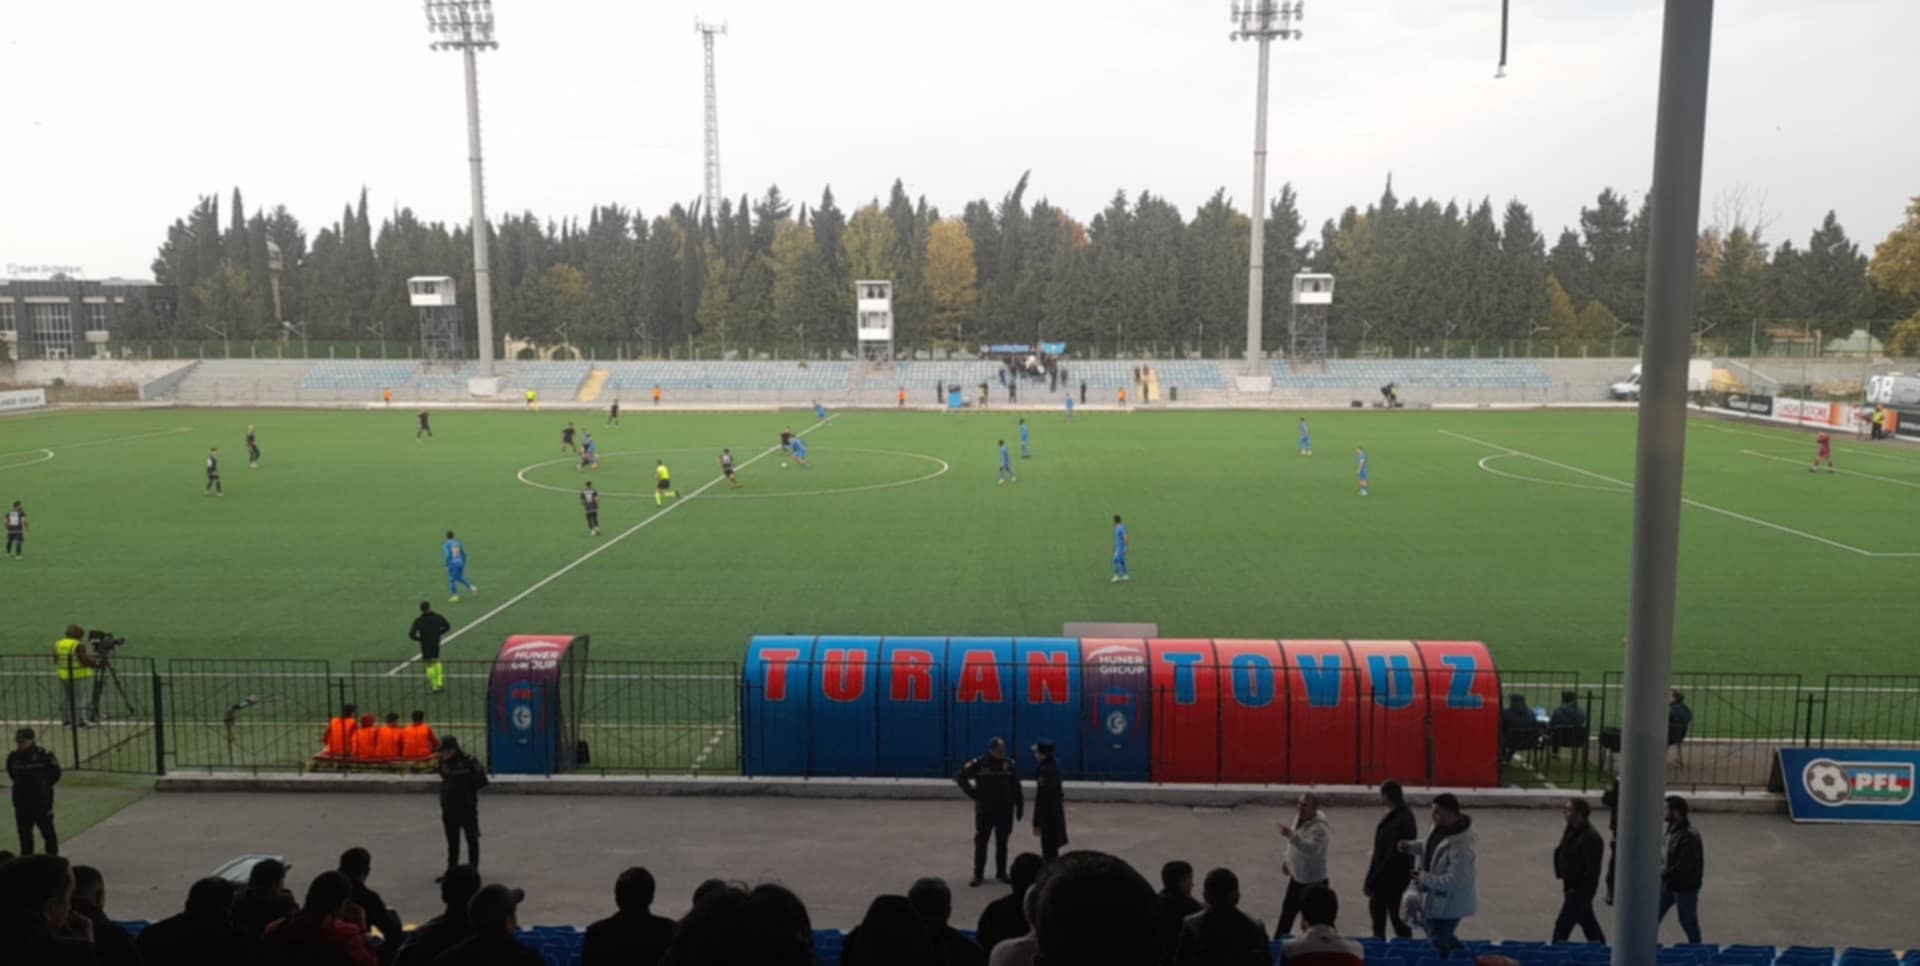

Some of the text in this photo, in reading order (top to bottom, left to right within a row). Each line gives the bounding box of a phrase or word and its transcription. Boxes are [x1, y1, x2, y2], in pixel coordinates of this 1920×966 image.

[1099, 656, 1144, 664] HUNER
[1100, 665, 1145, 674] GROUP
[759, 648, 1484, 708] TURAN TOVUZ
[1855, 773, 1903, 791] PFL
